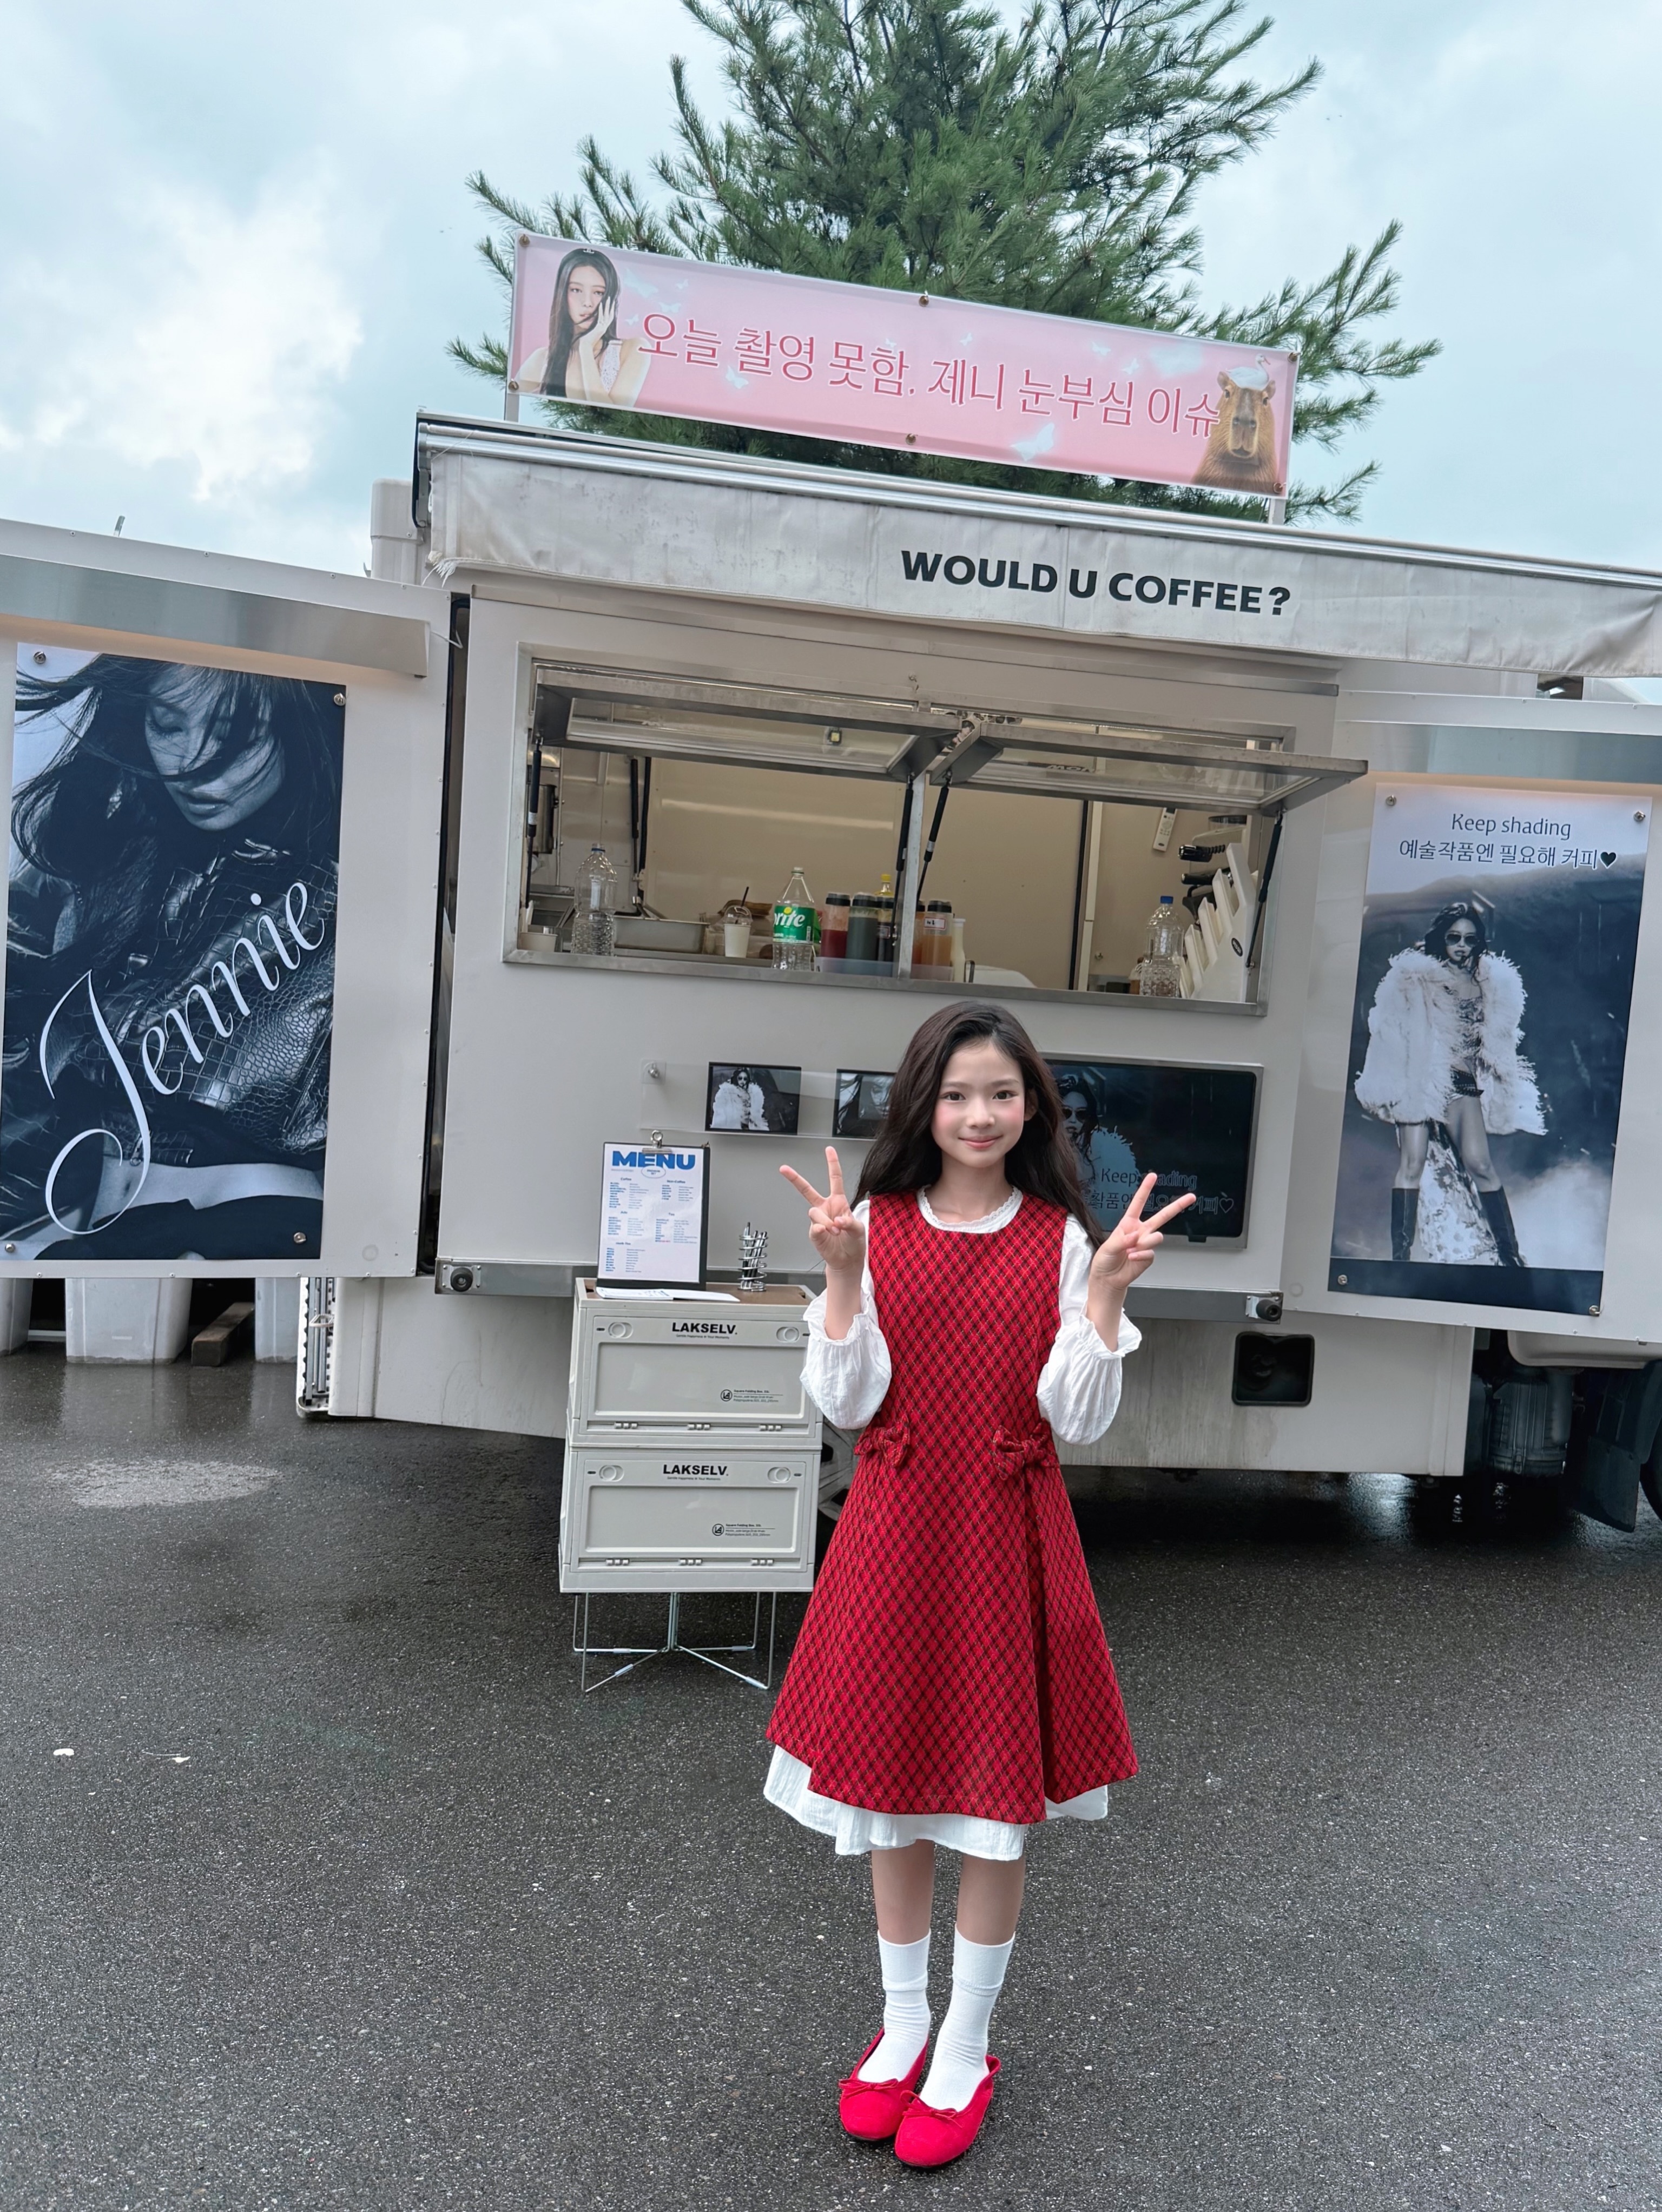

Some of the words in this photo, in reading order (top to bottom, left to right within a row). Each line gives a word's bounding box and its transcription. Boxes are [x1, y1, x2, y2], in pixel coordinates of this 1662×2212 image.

[637, 313, 722, 367] 오늘
[734, 327, 815, 381] 촬영
[829, 341, 915, 397] 못함.
[928, 359, 1005, 410] 제니
[1018, 369, 1134, 426] 눈부심
[1147, 388, 1220, 438] 이슈
[901, 550, 1058, 593] WOULD
[1069, 569, 1098, 598] U
[1108, 572, 1291, 616] COFFEE?
[1452, 813, 1496, 836] Keep
[1501, 816, 1571, 841] shading
[1399, 839, 1494, 863] 예술작품엔
[1499, 844, 1555, 867] 필요해
[1561, 849, 1598, 869] 커피
[774, 910, 806, 928] rite
[39, 882, 325, 1235] Jennie
[612, 1150, 696, 1170] MENU
[1100, 1168, 1137, 1187] Keep
[1142, 1170, 1198, 1191] ading
[672, 1322, 737, 1335] LAKSELV.
